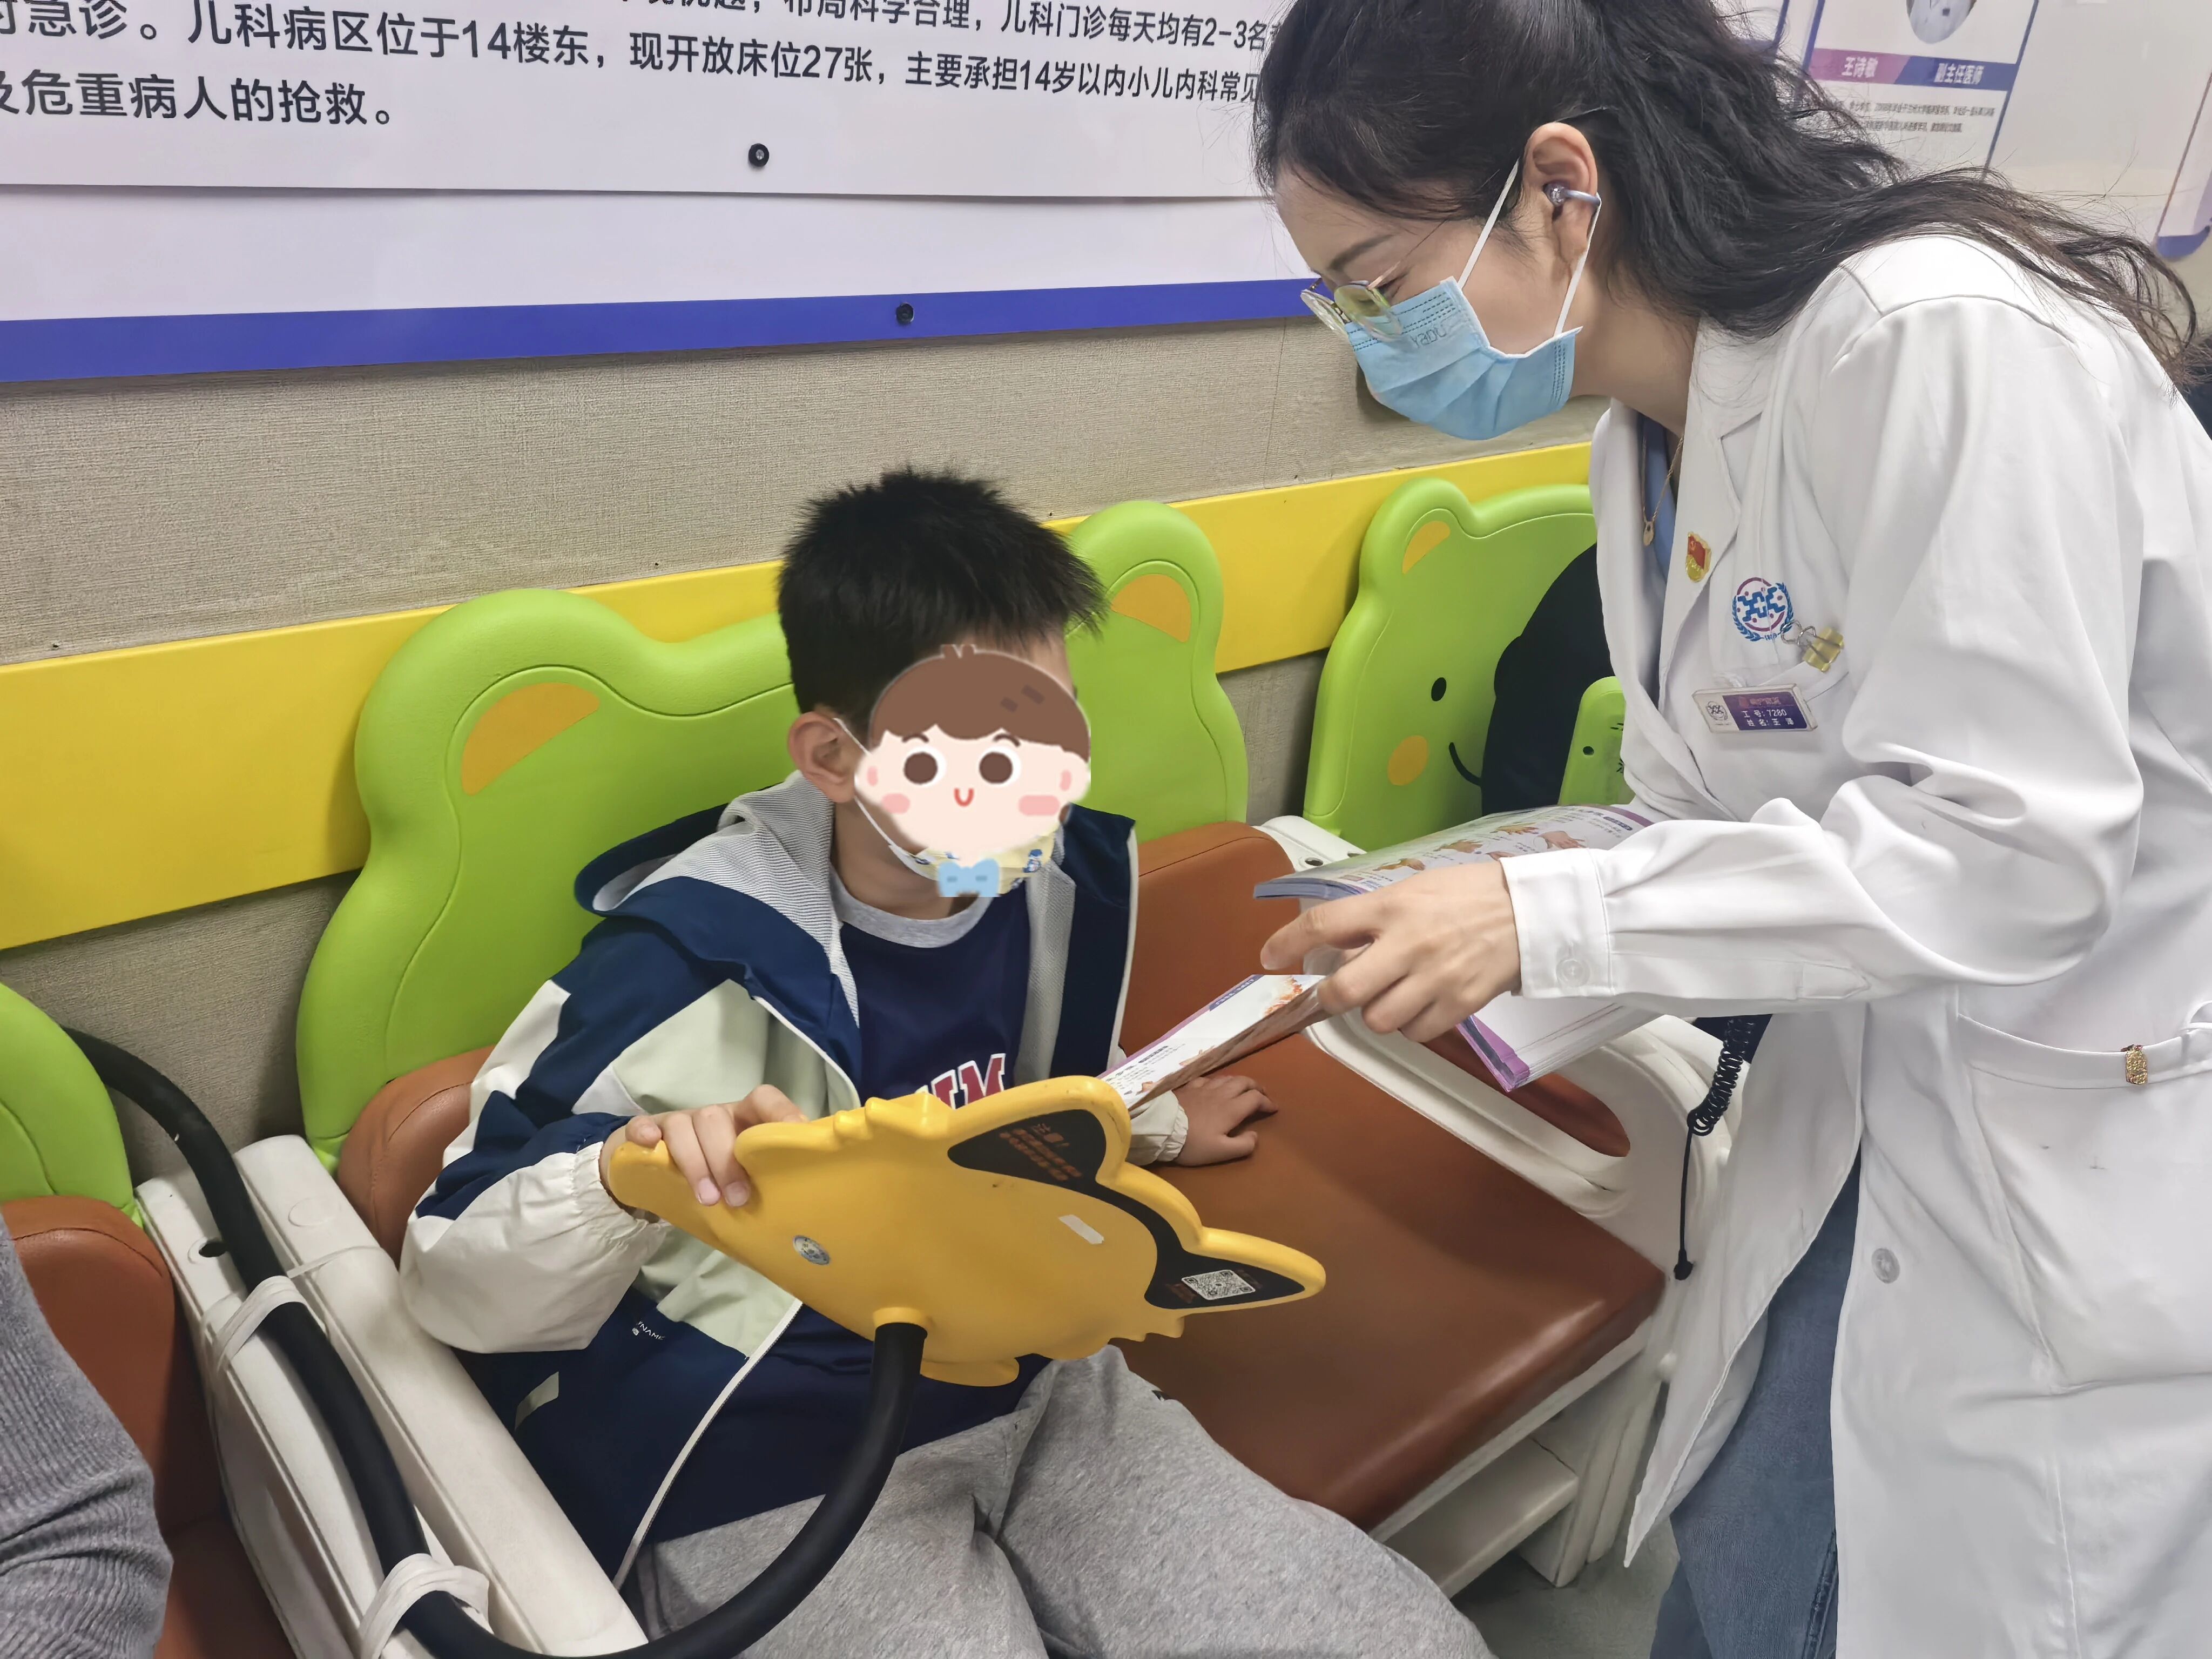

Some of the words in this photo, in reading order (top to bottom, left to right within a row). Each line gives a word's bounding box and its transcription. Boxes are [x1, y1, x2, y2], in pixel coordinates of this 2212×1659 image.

[648, 0, 1281, 52] ，局科学合理，儿科门诊每天均有2-3名
